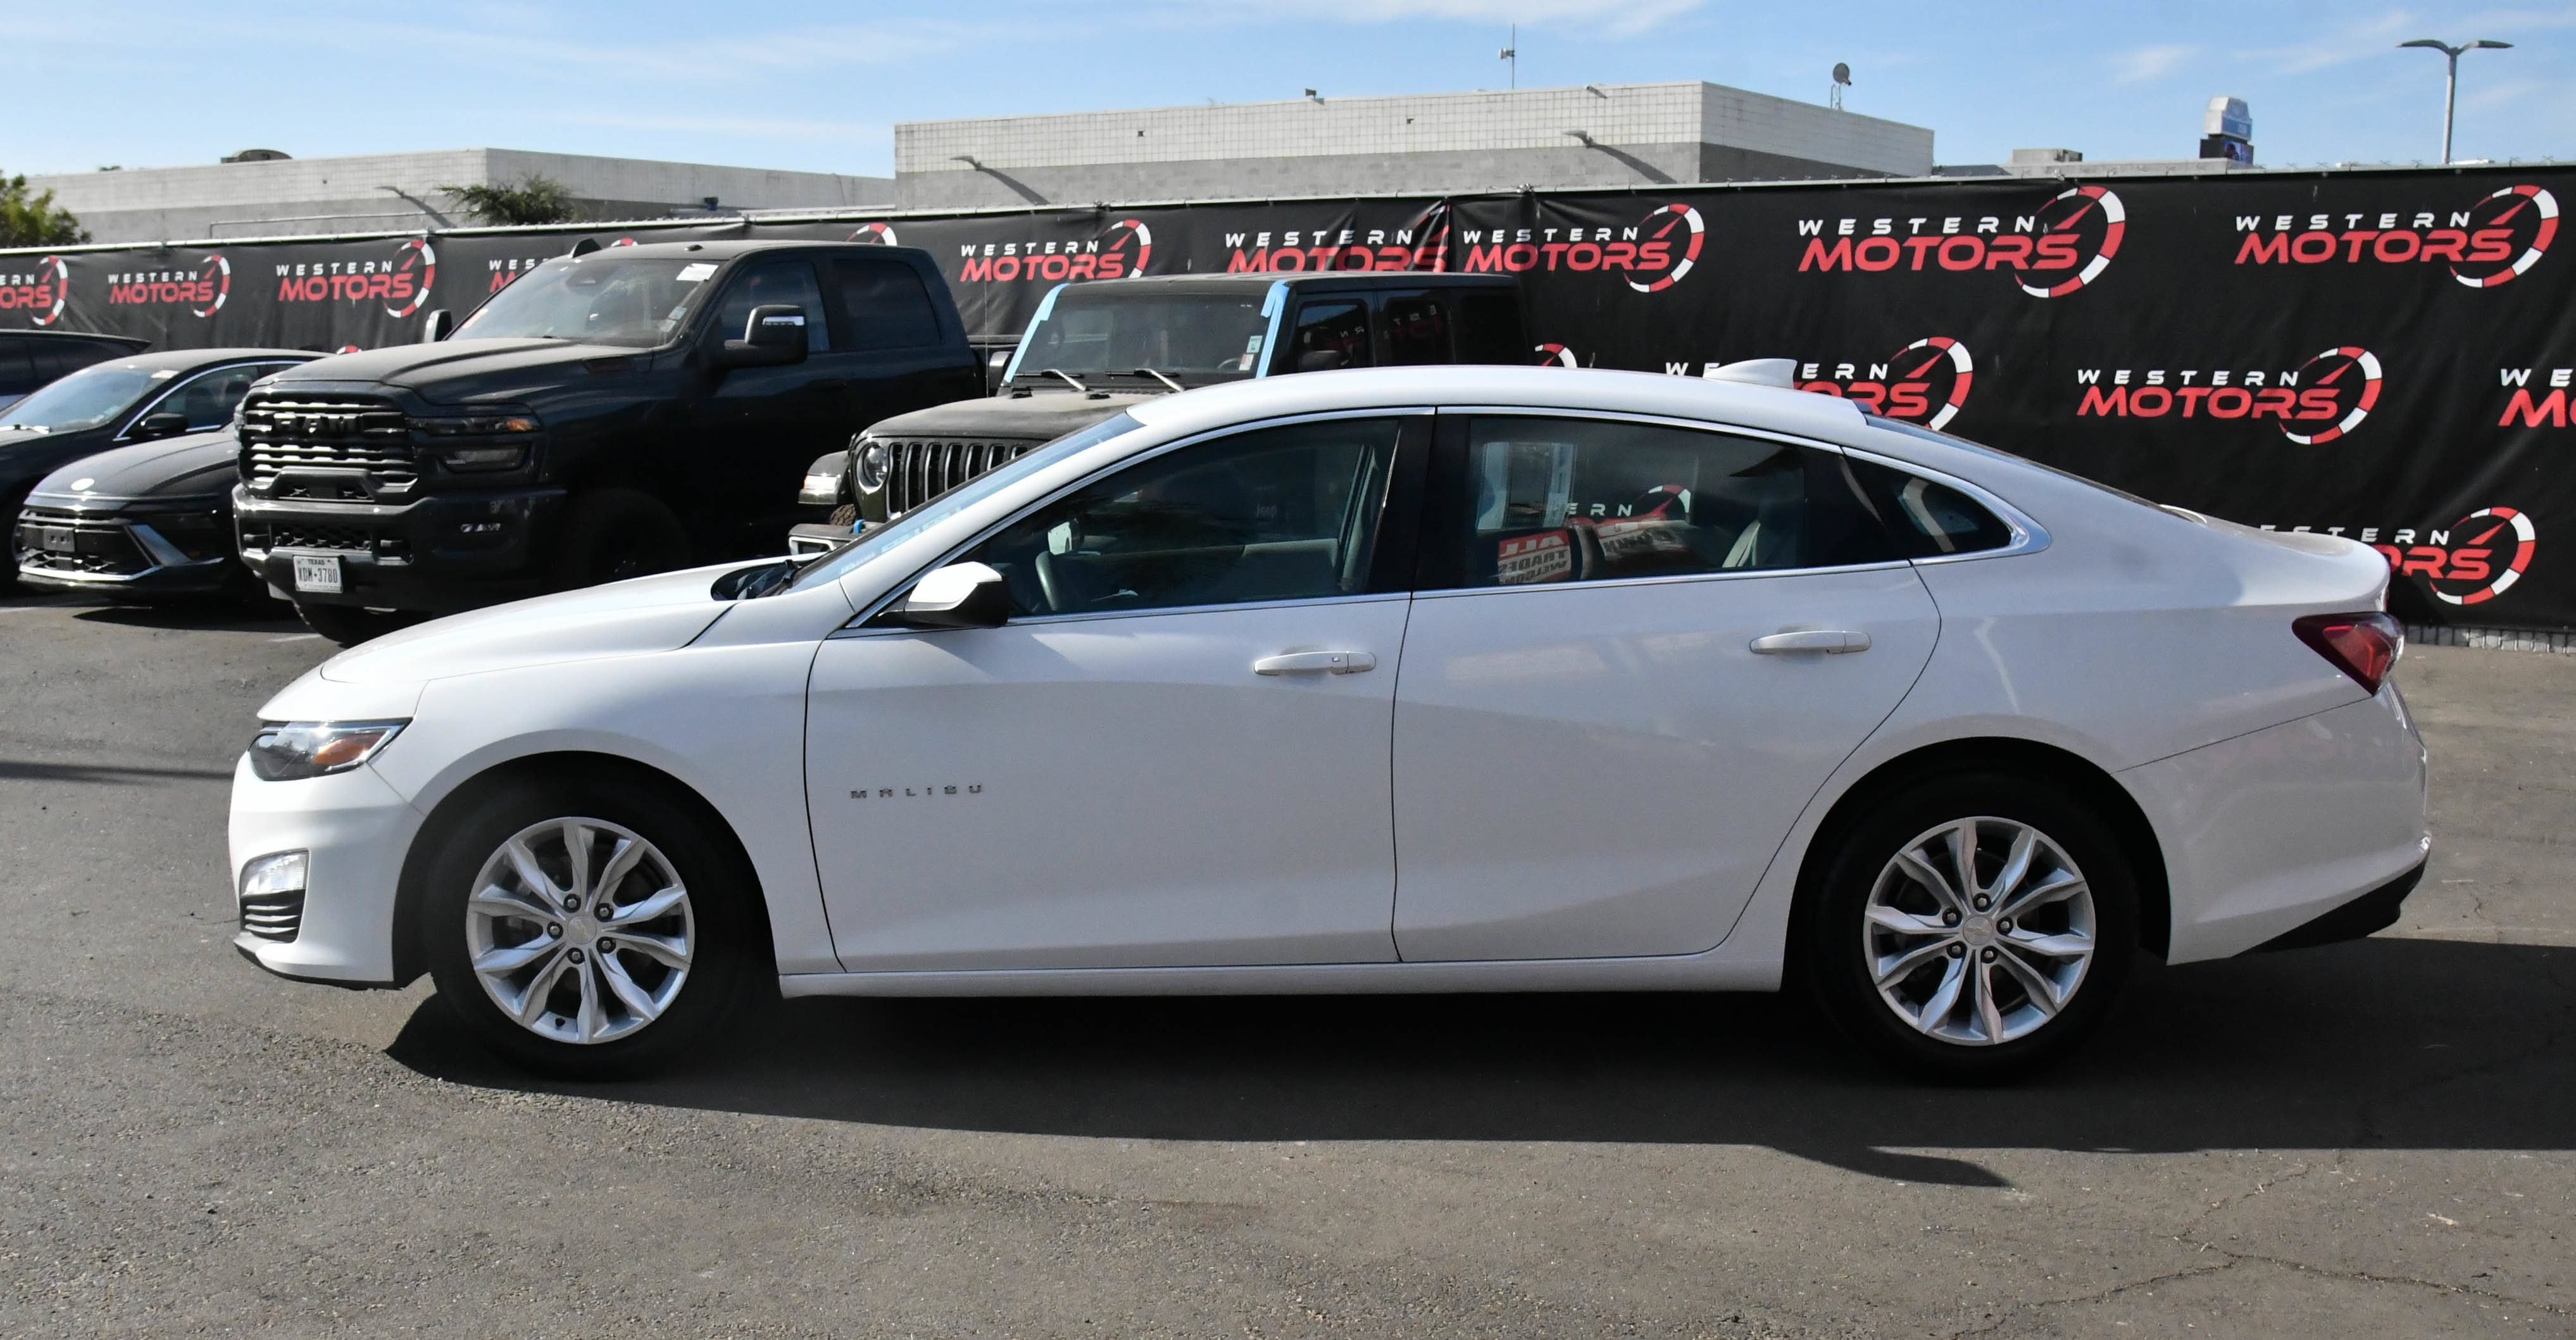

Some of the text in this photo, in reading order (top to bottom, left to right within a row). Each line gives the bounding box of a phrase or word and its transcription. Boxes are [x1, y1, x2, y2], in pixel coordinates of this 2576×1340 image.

[1799, 216, 2035, 237] WESTERN
[2236, 211, 2471, 232] WESTERN
[1225, 229, 1413, 247] WESTERN
[1463, 226, 1639, 245] WESTERN
[961, 240, 1099, 257] WESTERN
[1464, 241, 1672, 273] MOTORS
[1798, 234, 2081, 272] MOTORS
[2234, 228, 2515, 265] MOTORS
[276, 260, 393, 277] WESTERN
[960, 253, 1125, 282] MOTORS
[1227, 245, 1447, 273] MOTORS
[108, 270, 197, 284] WESTERN
[277, 273, 414, 302] MOTORS
[110, 280, 214, 304] MOTORS
[2078, 369, 2299, 387] WESTERN
[2077, 385, 2341, 420] MOTORS
[851, 785, 982, 799] MALIBU
